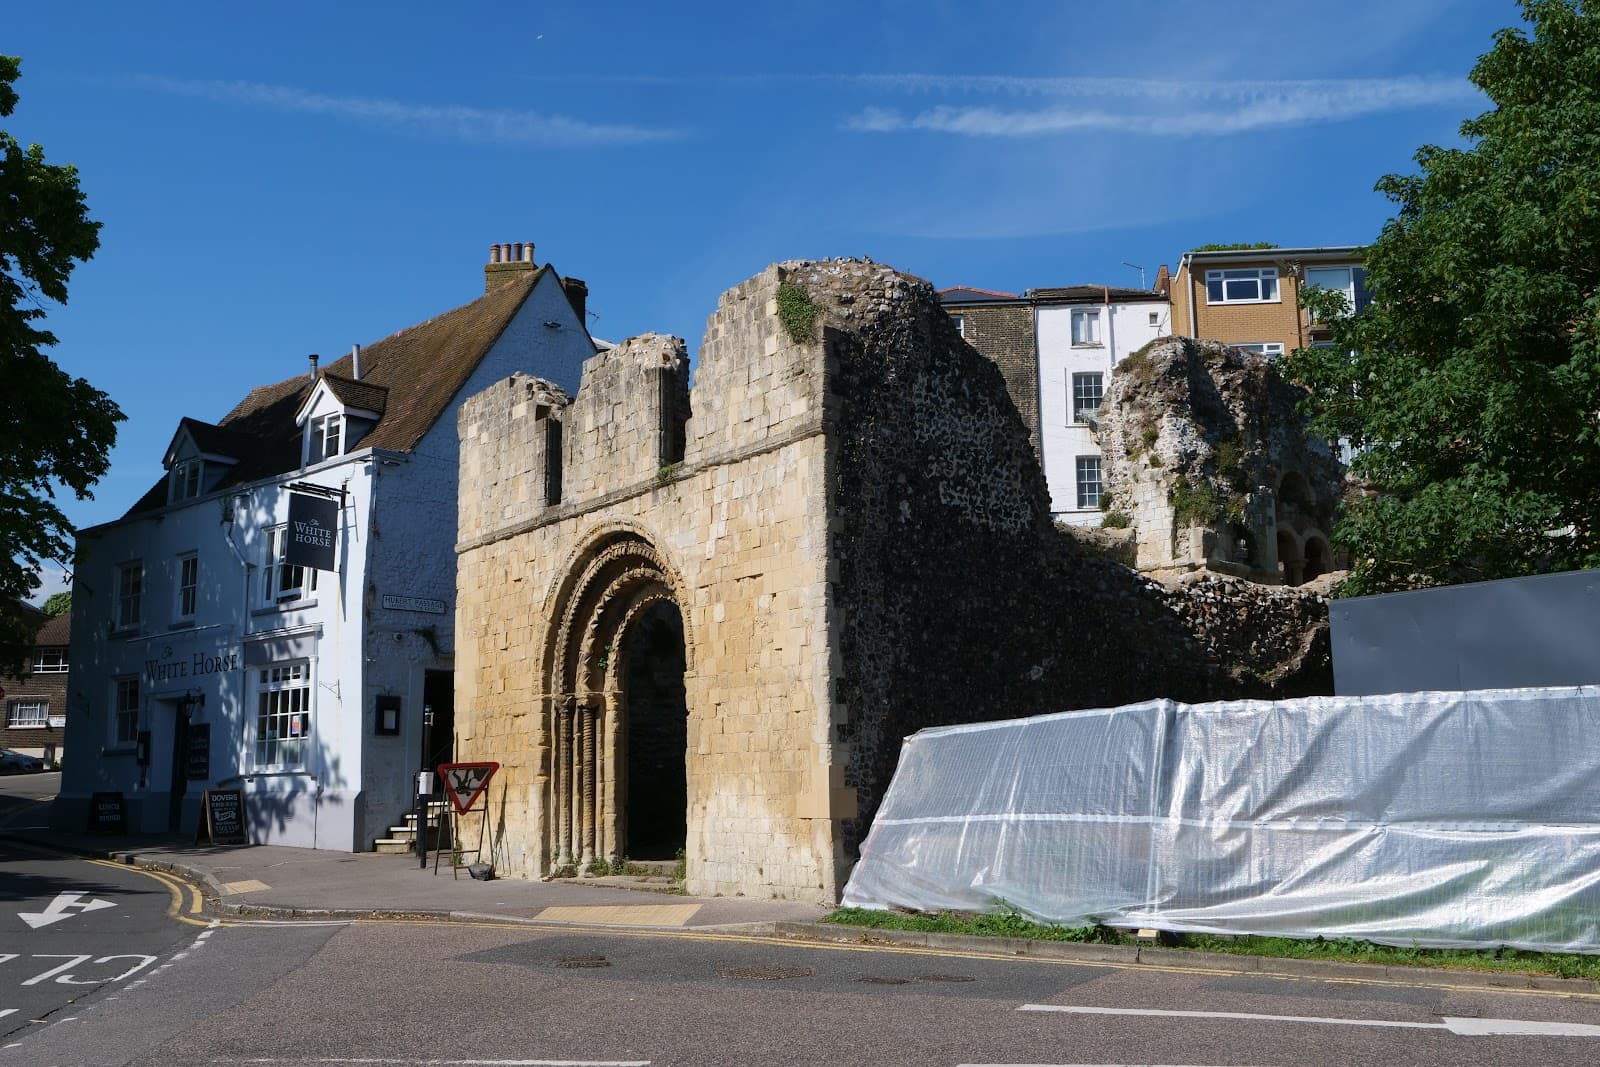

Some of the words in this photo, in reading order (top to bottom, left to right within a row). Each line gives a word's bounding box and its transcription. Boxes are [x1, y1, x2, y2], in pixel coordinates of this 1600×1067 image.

[294, 521, 332, 539] WHITE
[295, 533, 331, 548] HORSE
[145, 660, 188, 681] WHITE
[192, 652, 238, 676] HORSE
